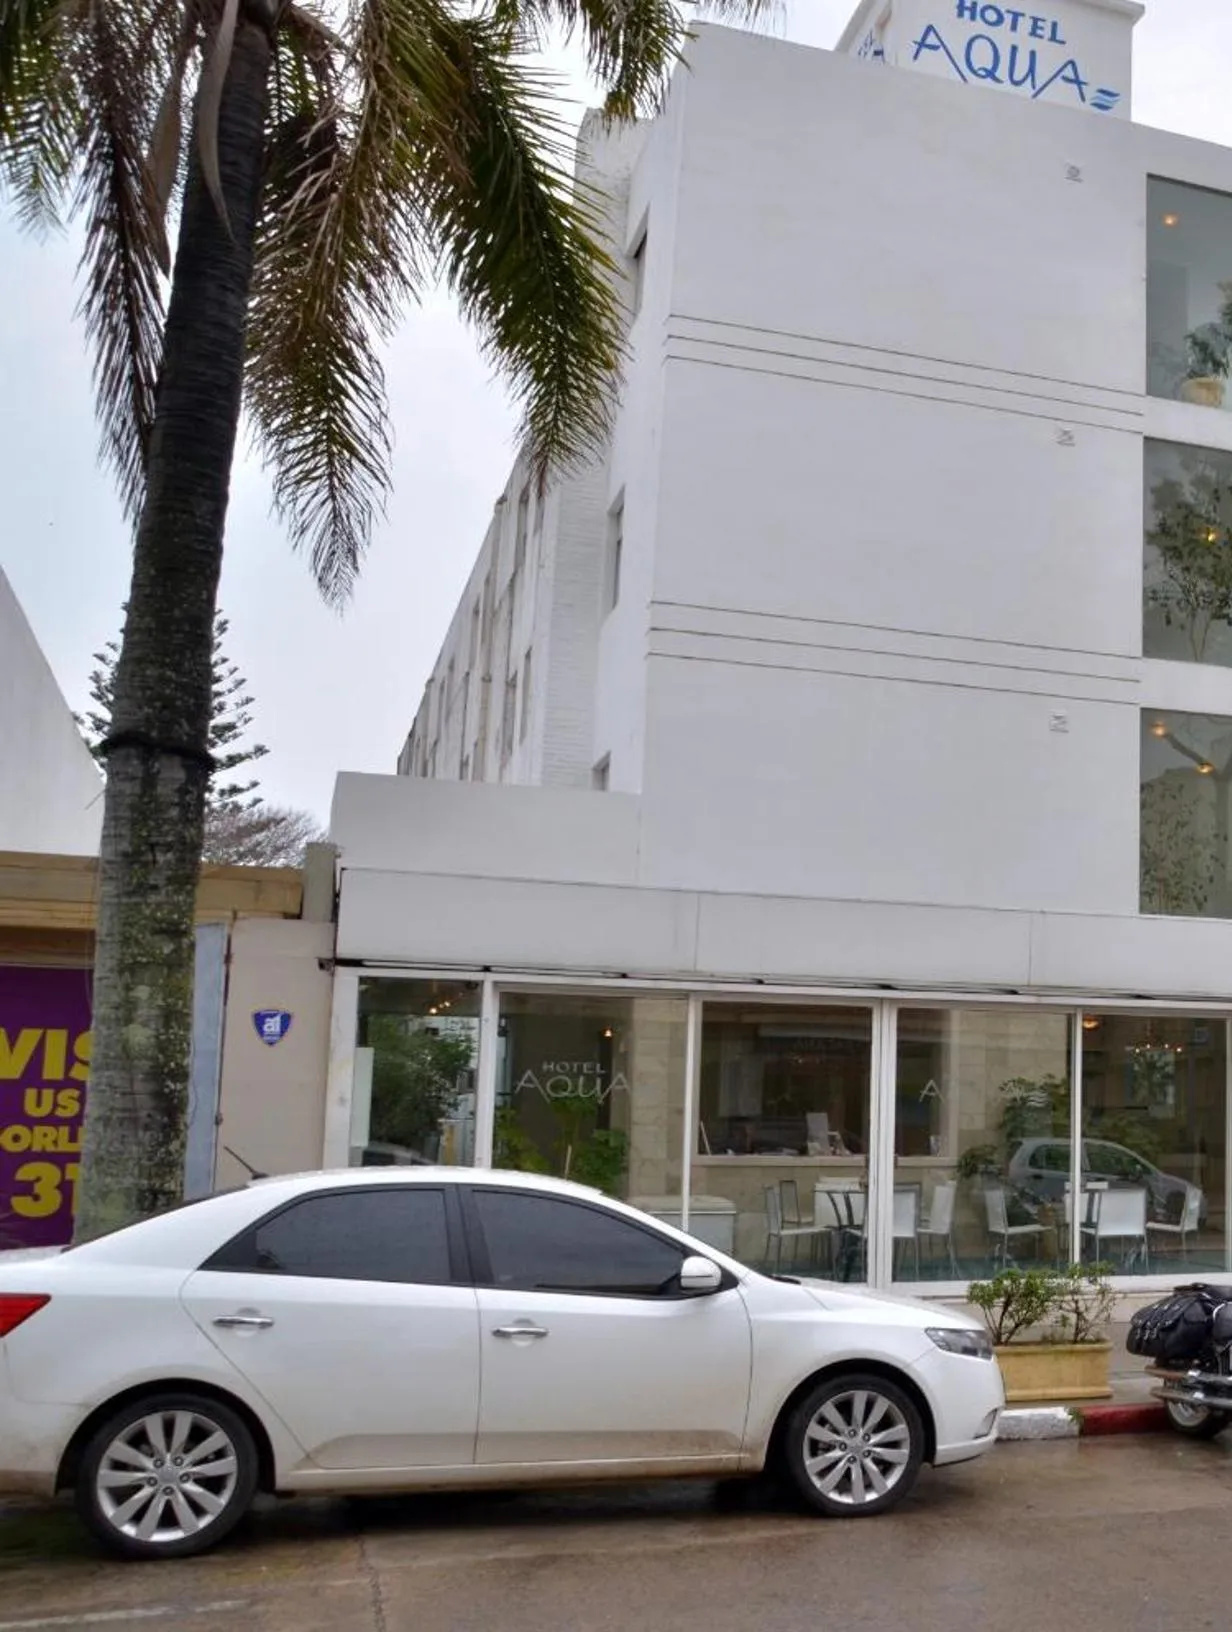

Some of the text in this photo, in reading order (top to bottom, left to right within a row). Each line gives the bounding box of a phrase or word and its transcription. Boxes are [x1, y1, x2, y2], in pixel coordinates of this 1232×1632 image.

[956, 0, 1066, 45] HOTEL
[912, 24, 1089, 103] AQUA
[0, 1028, 92, 1080] VIS
[542, 1061, 606, 1074] HOTEL
[24, 1088, 81, 1118] US
[514, 1069, 632, 1105] AQUA
